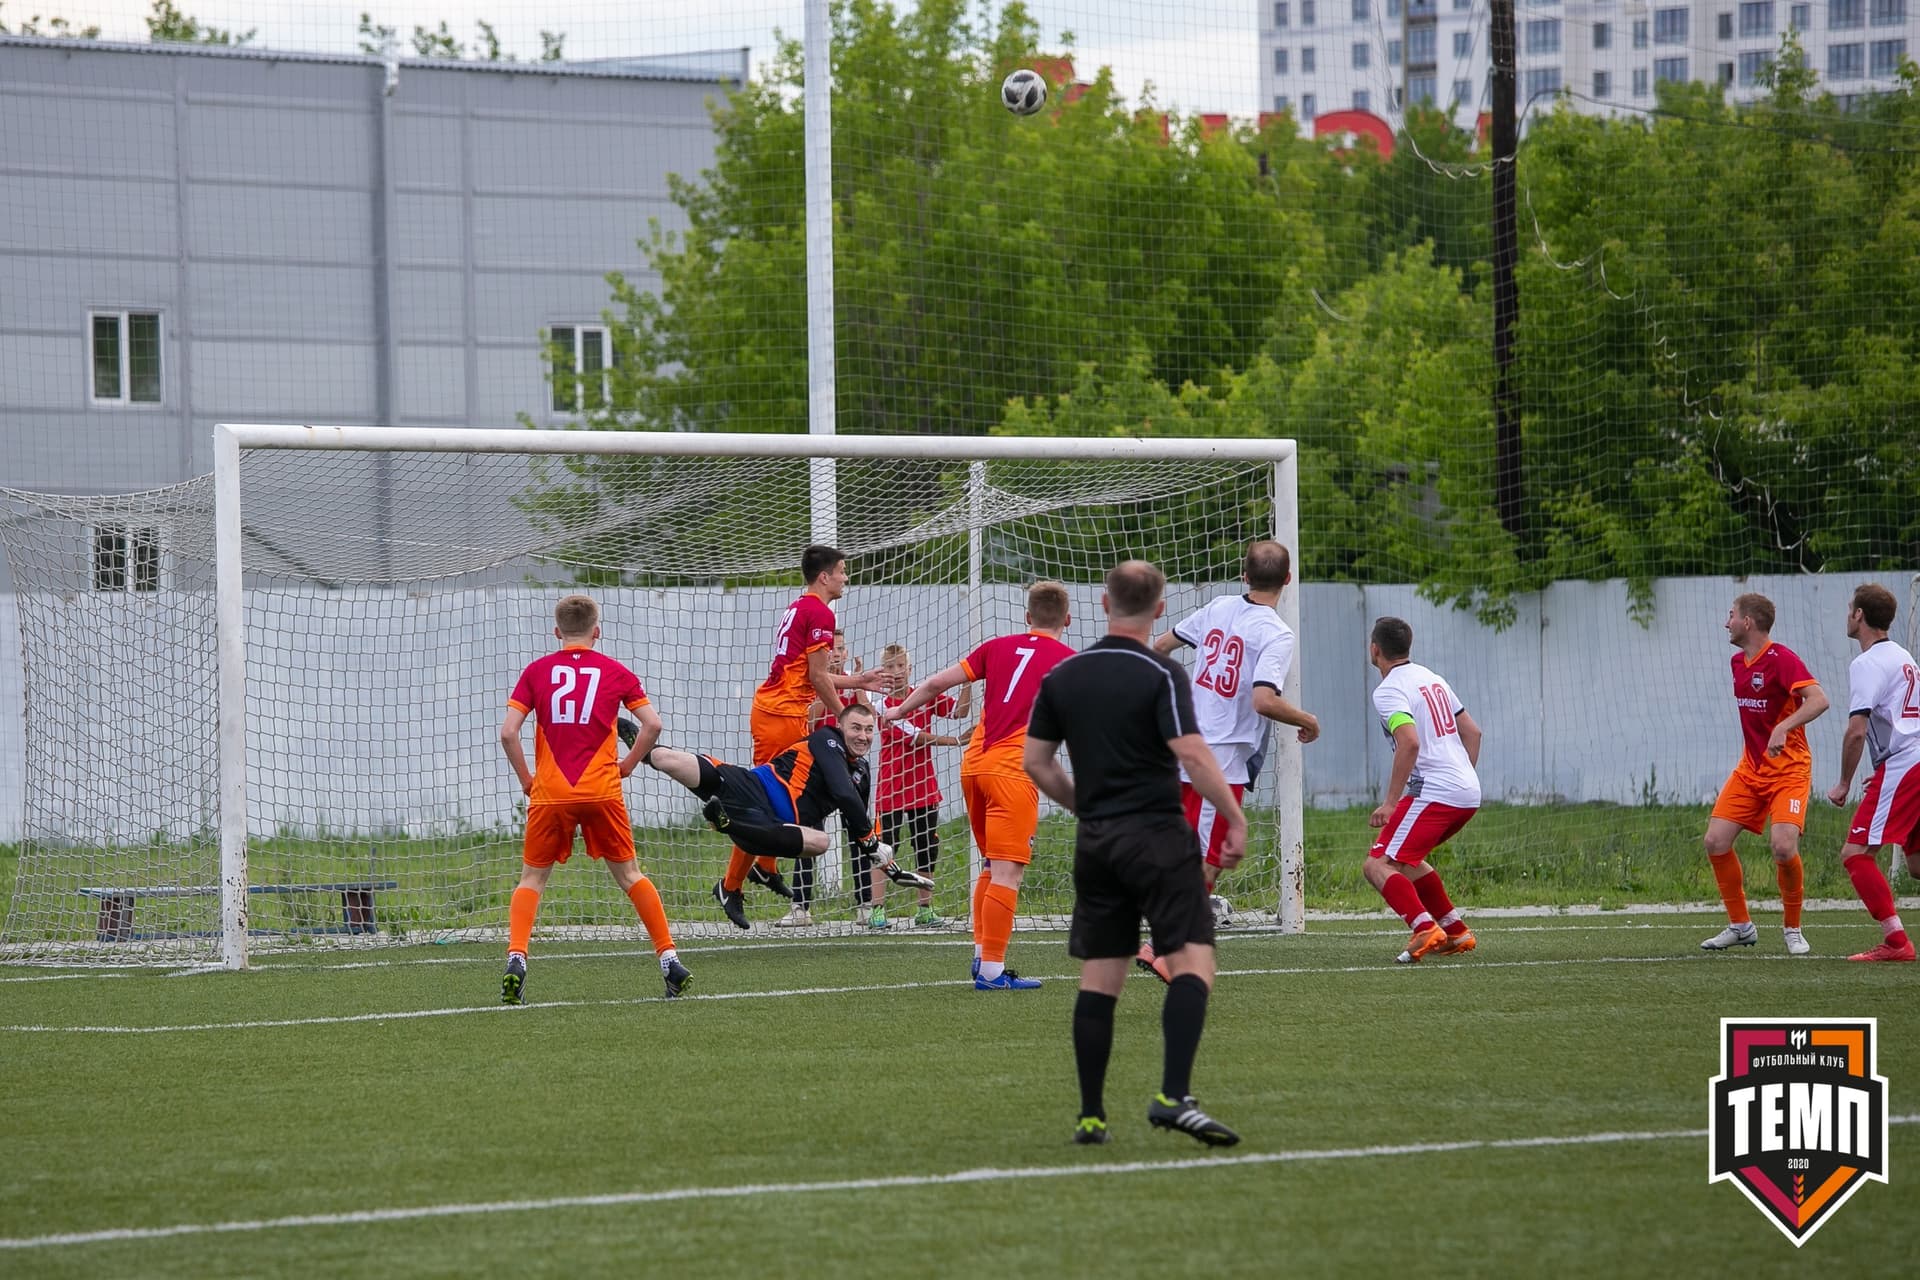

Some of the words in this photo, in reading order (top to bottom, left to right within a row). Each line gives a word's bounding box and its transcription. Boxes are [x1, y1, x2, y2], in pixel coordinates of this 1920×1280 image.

[1003, 646, 1036, 703] 7
[1195, 628, 1244, 699] 23
[1901, 663, 1920, 718] 2
[551, 664, 601, 725] 27
[1419, 683, 1457, 737] 10
